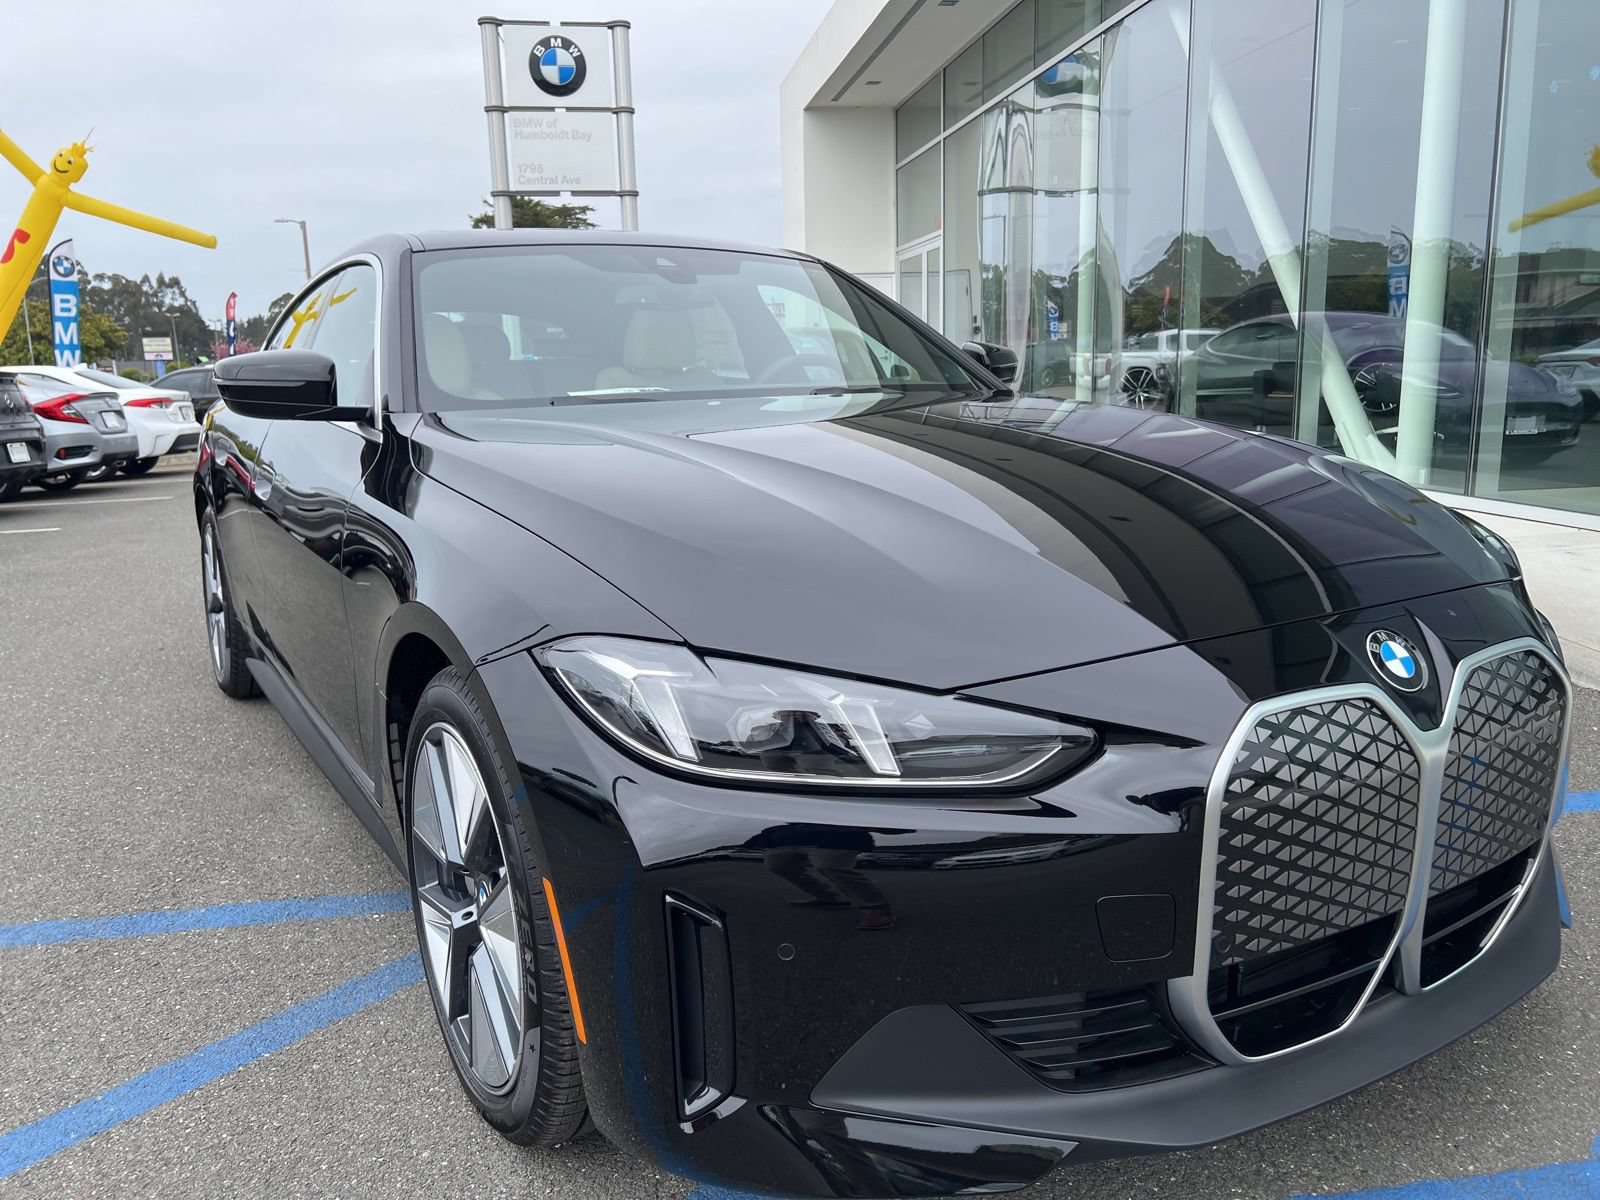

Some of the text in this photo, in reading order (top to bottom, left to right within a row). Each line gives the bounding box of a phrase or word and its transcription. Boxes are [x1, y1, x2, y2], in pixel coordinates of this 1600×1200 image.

[533, 37, 580, 57] BMW
[514, 118, 558, 128] BMW of
[514, 129, 592, 142] Humboldt Bay
[517, 163, 544, 174] 1795
[518, 175, 582, 185] Central Ave
[53, 293, 80, 368] BMW
[1369, 632, 1406, 653] BMW
[516, 889, 538, 1005] ZERO
